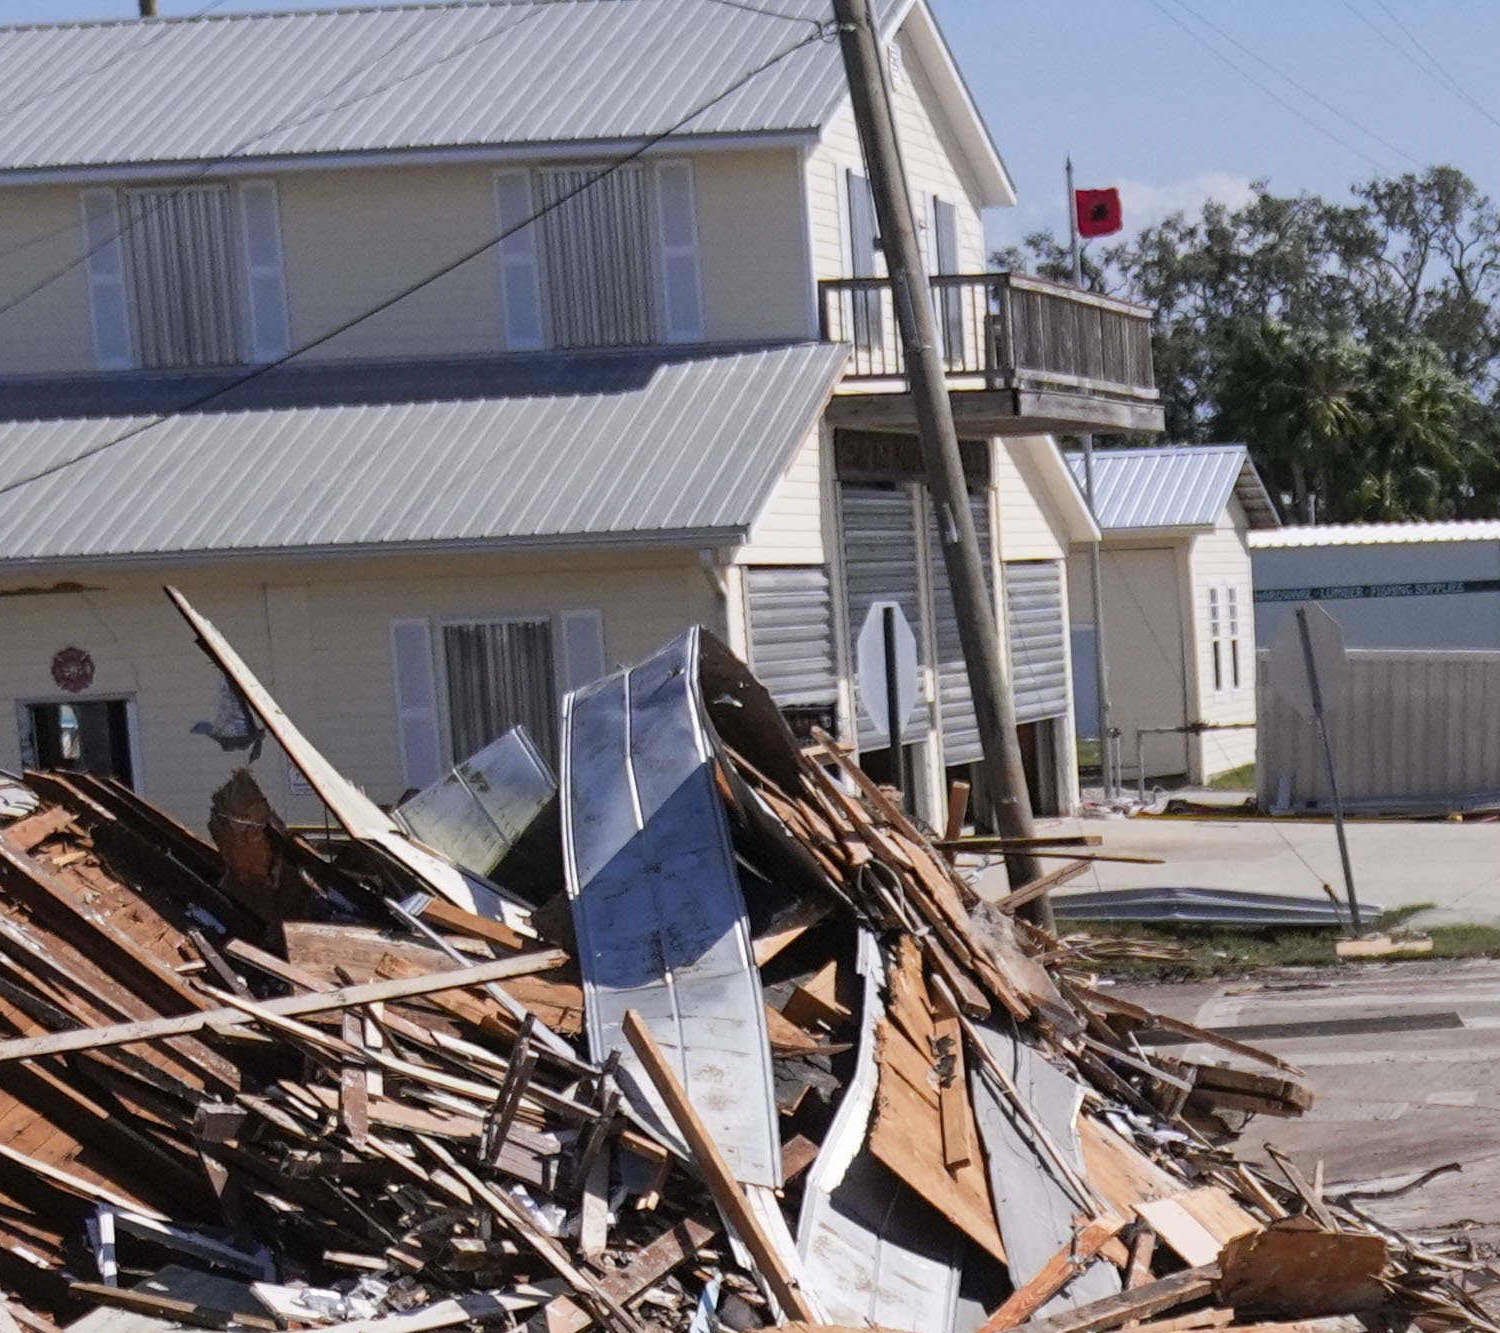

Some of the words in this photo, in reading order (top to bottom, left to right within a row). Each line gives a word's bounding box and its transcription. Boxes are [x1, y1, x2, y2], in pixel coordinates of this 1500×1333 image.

[1321, 587, 1365, 598] LUMBER
[1372, 585, 1412, 597] FISHING
[1414, 582, 1466, 595] SUPPLIES
